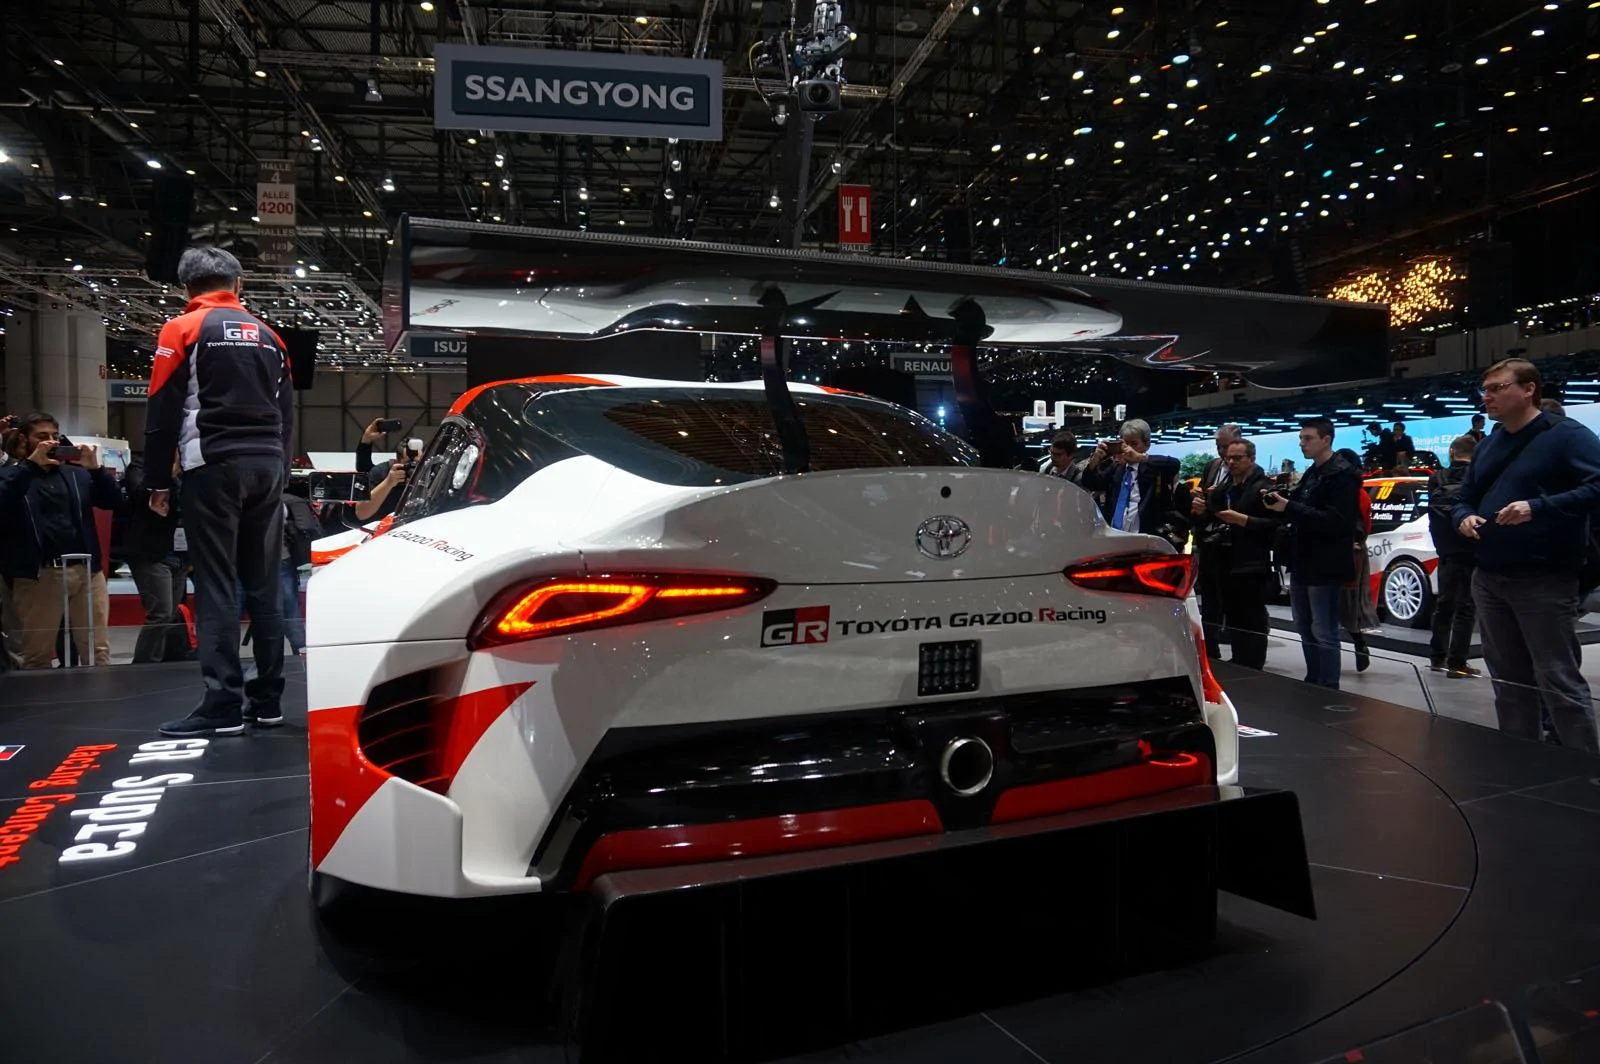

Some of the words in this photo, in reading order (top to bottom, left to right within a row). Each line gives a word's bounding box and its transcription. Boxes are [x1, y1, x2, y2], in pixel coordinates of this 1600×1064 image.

[465, 75, 694, 111] SSANGYONG
[261, 162, 291, 171] HALLE
[271, 172, 281, 184] 4
[258, 202, 294, 215] 4200
[841, 243, 869, 252] HALLE
[226, 328, 258, 340] GR
[434, 341, 467, 353] ISUZ
[904, 361, 952, 372] RENAU
[124, 386, 150, 395] SUZ
[1376, 481, 1395, 500] 10
[428, 540, 474, 562] Racing
[1367, 538, 1392, 557] soft
[836, 616, 942, 636] TOYOTA
[950, 611, 1033, 628] GAZOO
[1038, 607, 1106, 623] Racing
[763, 621, 828, 647] GR
[128, 738, 210, 764] GR
[28, 743, 118, 789] Racing
[58, 773, 194, 863] Supra
